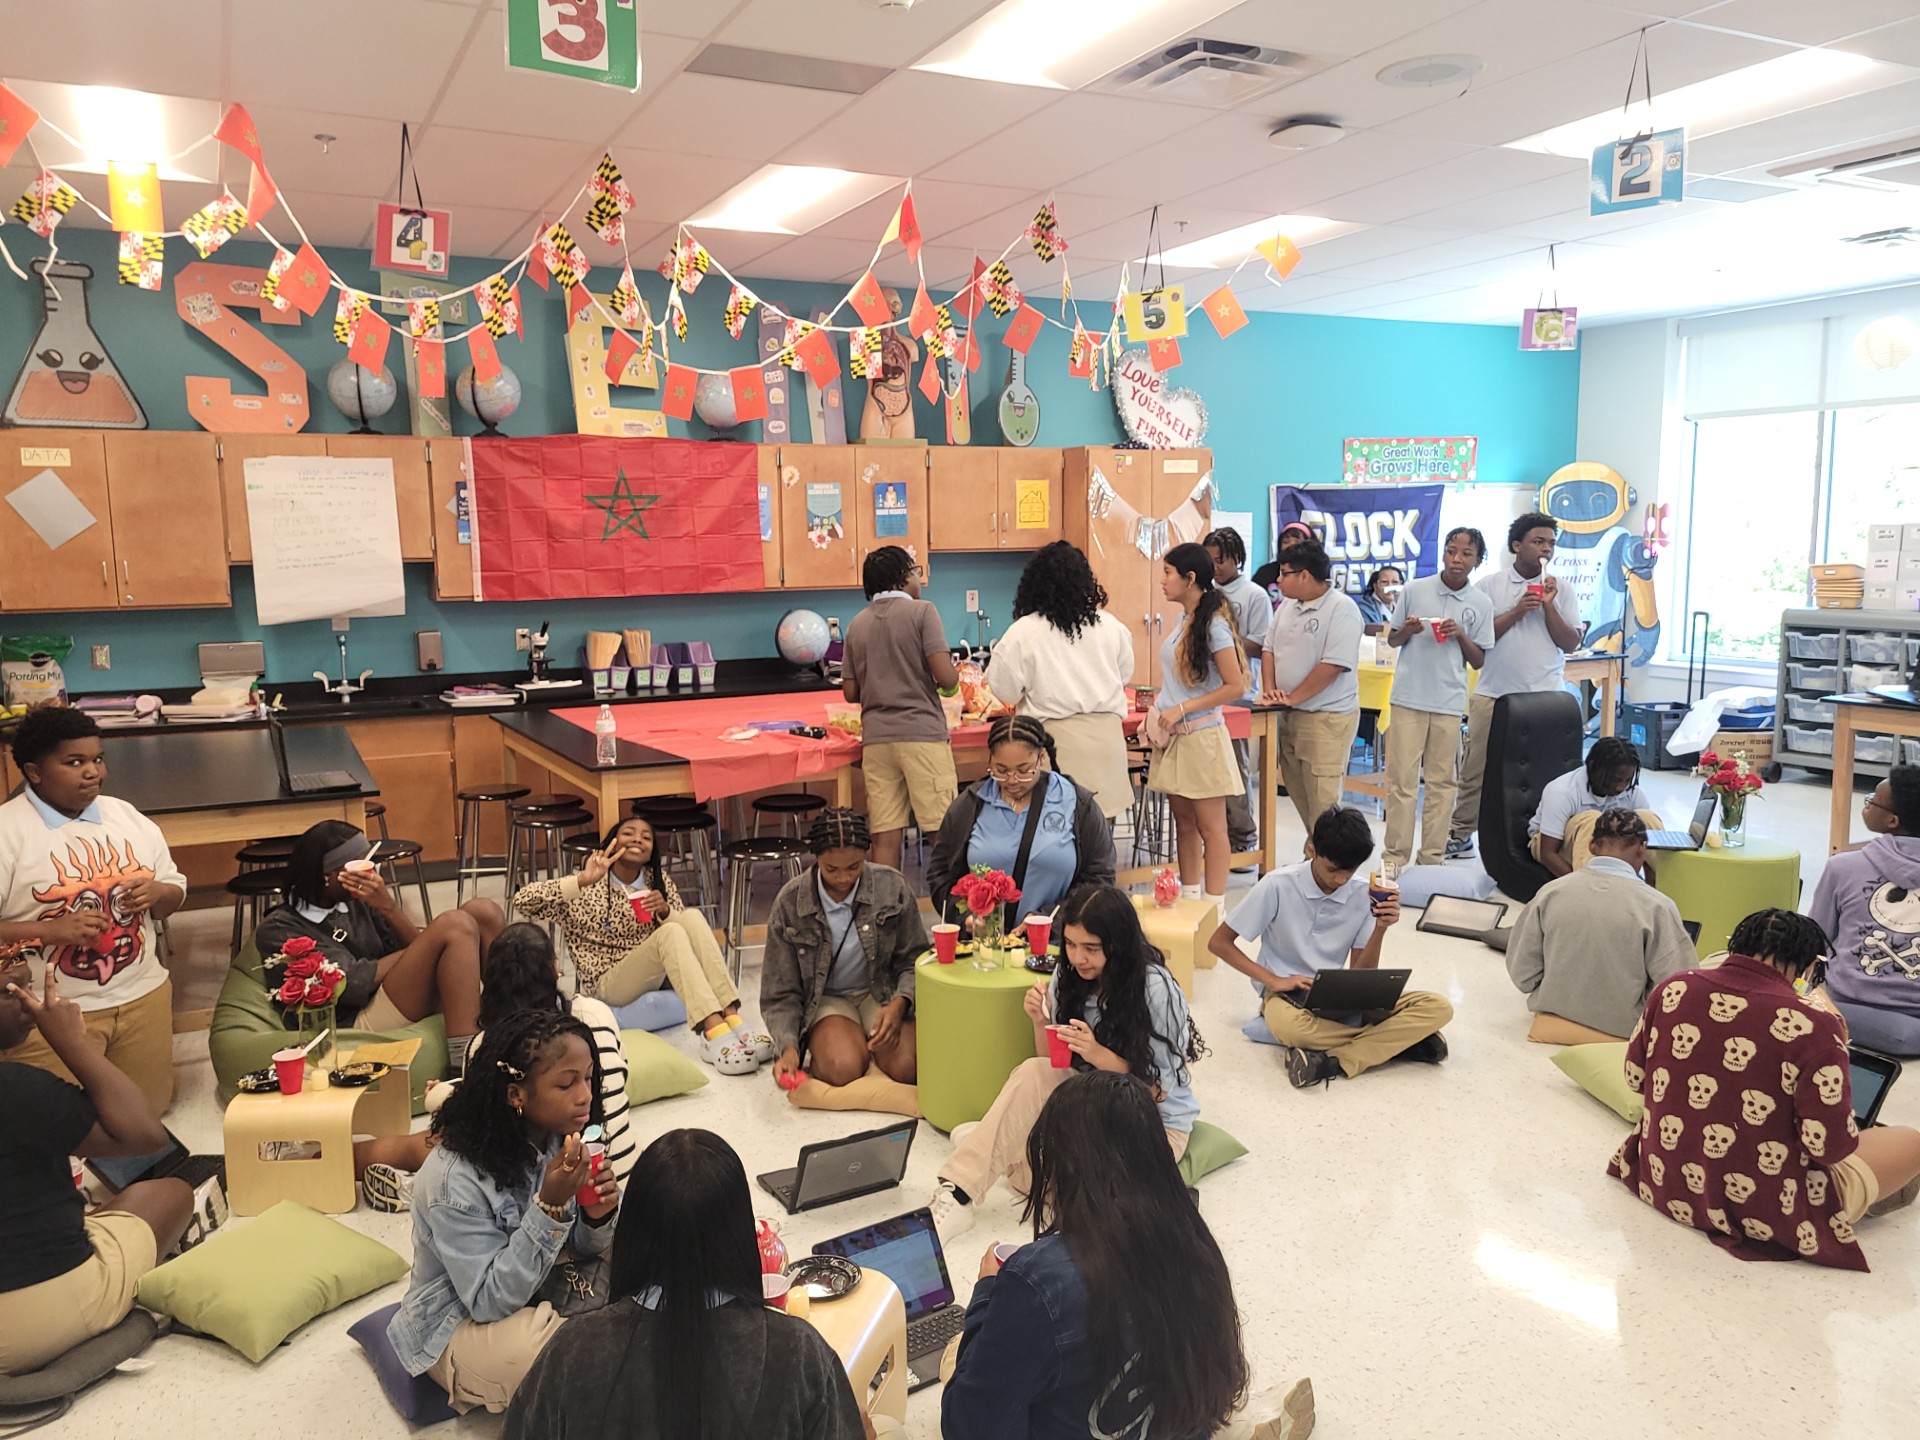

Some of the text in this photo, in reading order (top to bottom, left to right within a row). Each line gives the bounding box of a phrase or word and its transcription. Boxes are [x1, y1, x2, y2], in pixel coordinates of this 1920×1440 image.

[542, 0, 606, 61] 3
[1619, 144, 1653, 197] 2
[397, 216, 428, 261] 4
[1143, 296, 1166, 330] 5
[1535, 312, 1564, 342] 6
[1136, 417, 1172, 446] FIRST
[23, 449, 67, 461] DATA
[1370, 458, 1450, 475] Grows Here
[1382, 446, 1439, 459] Great Work
[1553, 556, 1590, 567] Cross
[10, 671, 46, 683] Potting
